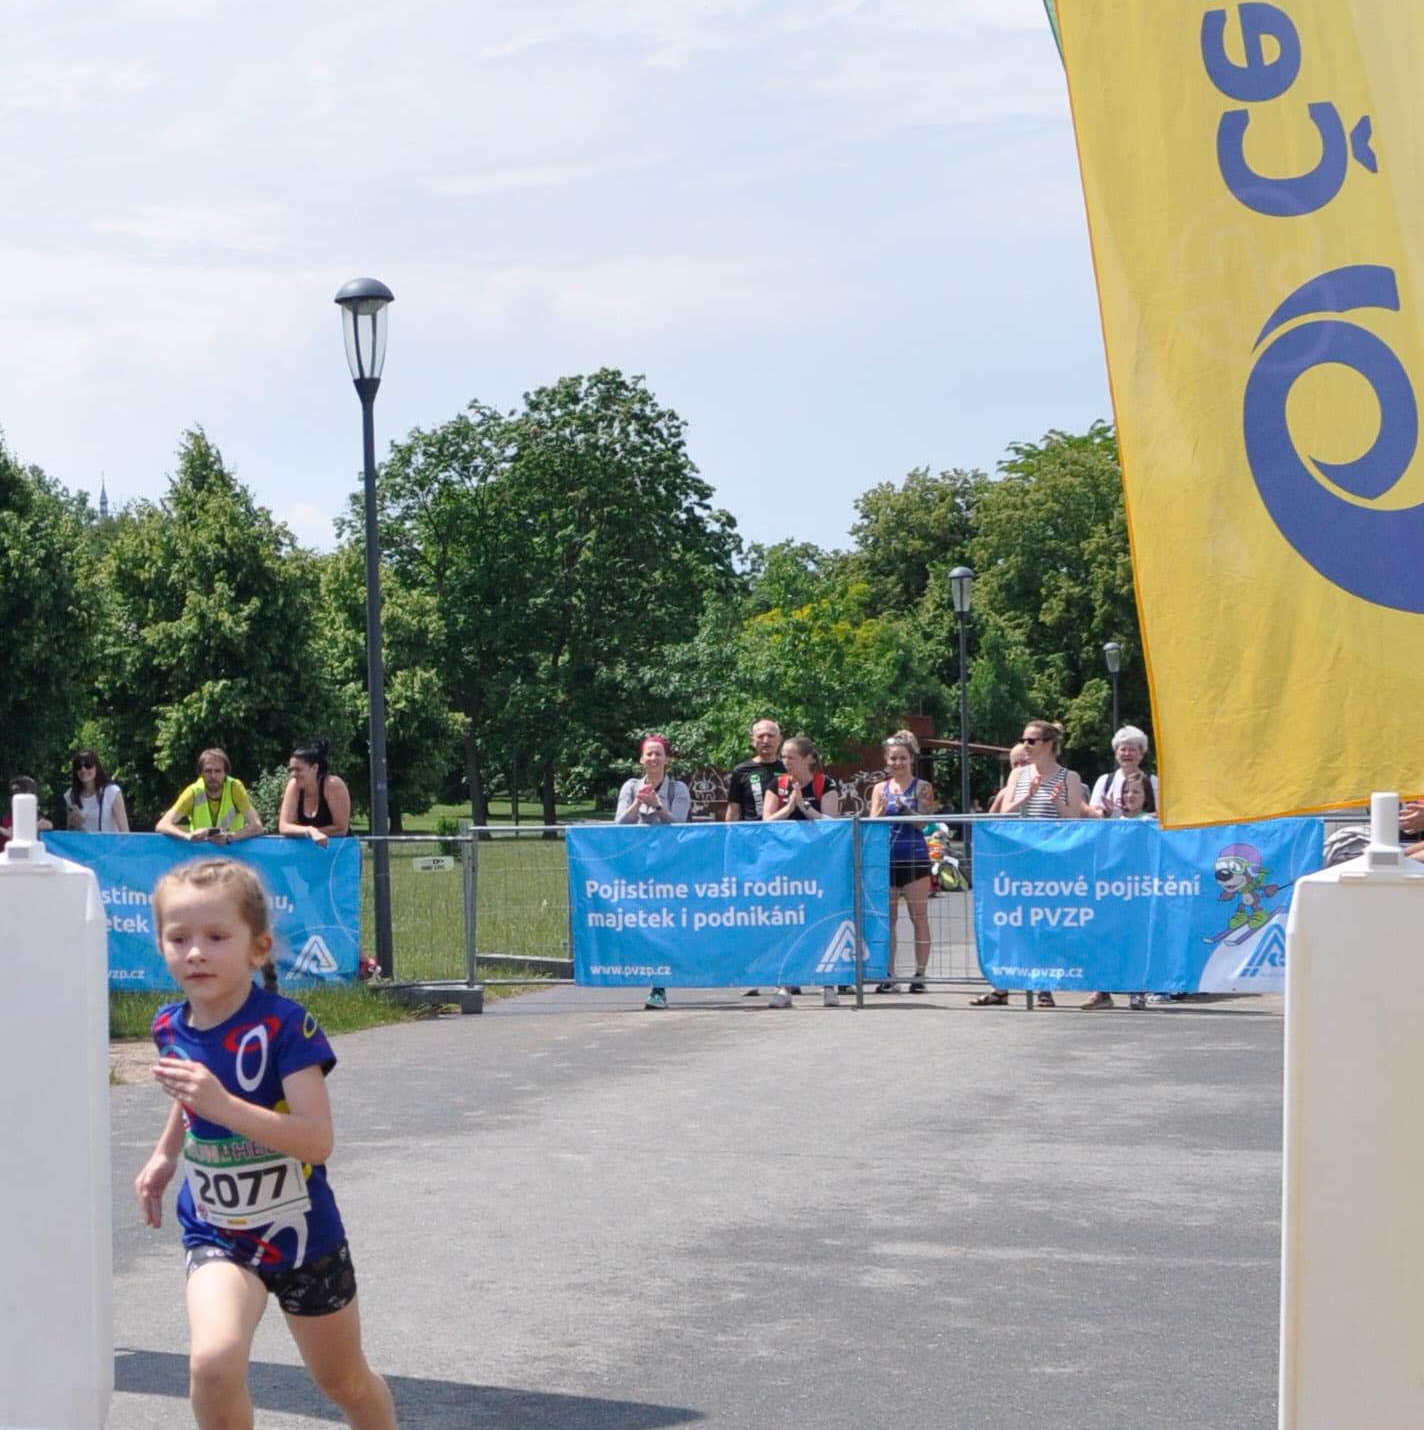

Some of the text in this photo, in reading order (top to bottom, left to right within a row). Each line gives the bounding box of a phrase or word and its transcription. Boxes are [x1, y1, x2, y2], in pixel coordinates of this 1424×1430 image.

[585, 876, 824, 903] Pojistíme vaši rodinu,
[993, 872, 1201, 901] Úrazové pojištění
[587, 905, 806, 931] majetek i podnikání
[993, 906, 1095, 927] od PVZP
[590, 964, 671, 977] www.pvzp.cz
[993, 966, 1083, 980] www.pvzp.cz
[194, 1164, 287, 1208] 2077
